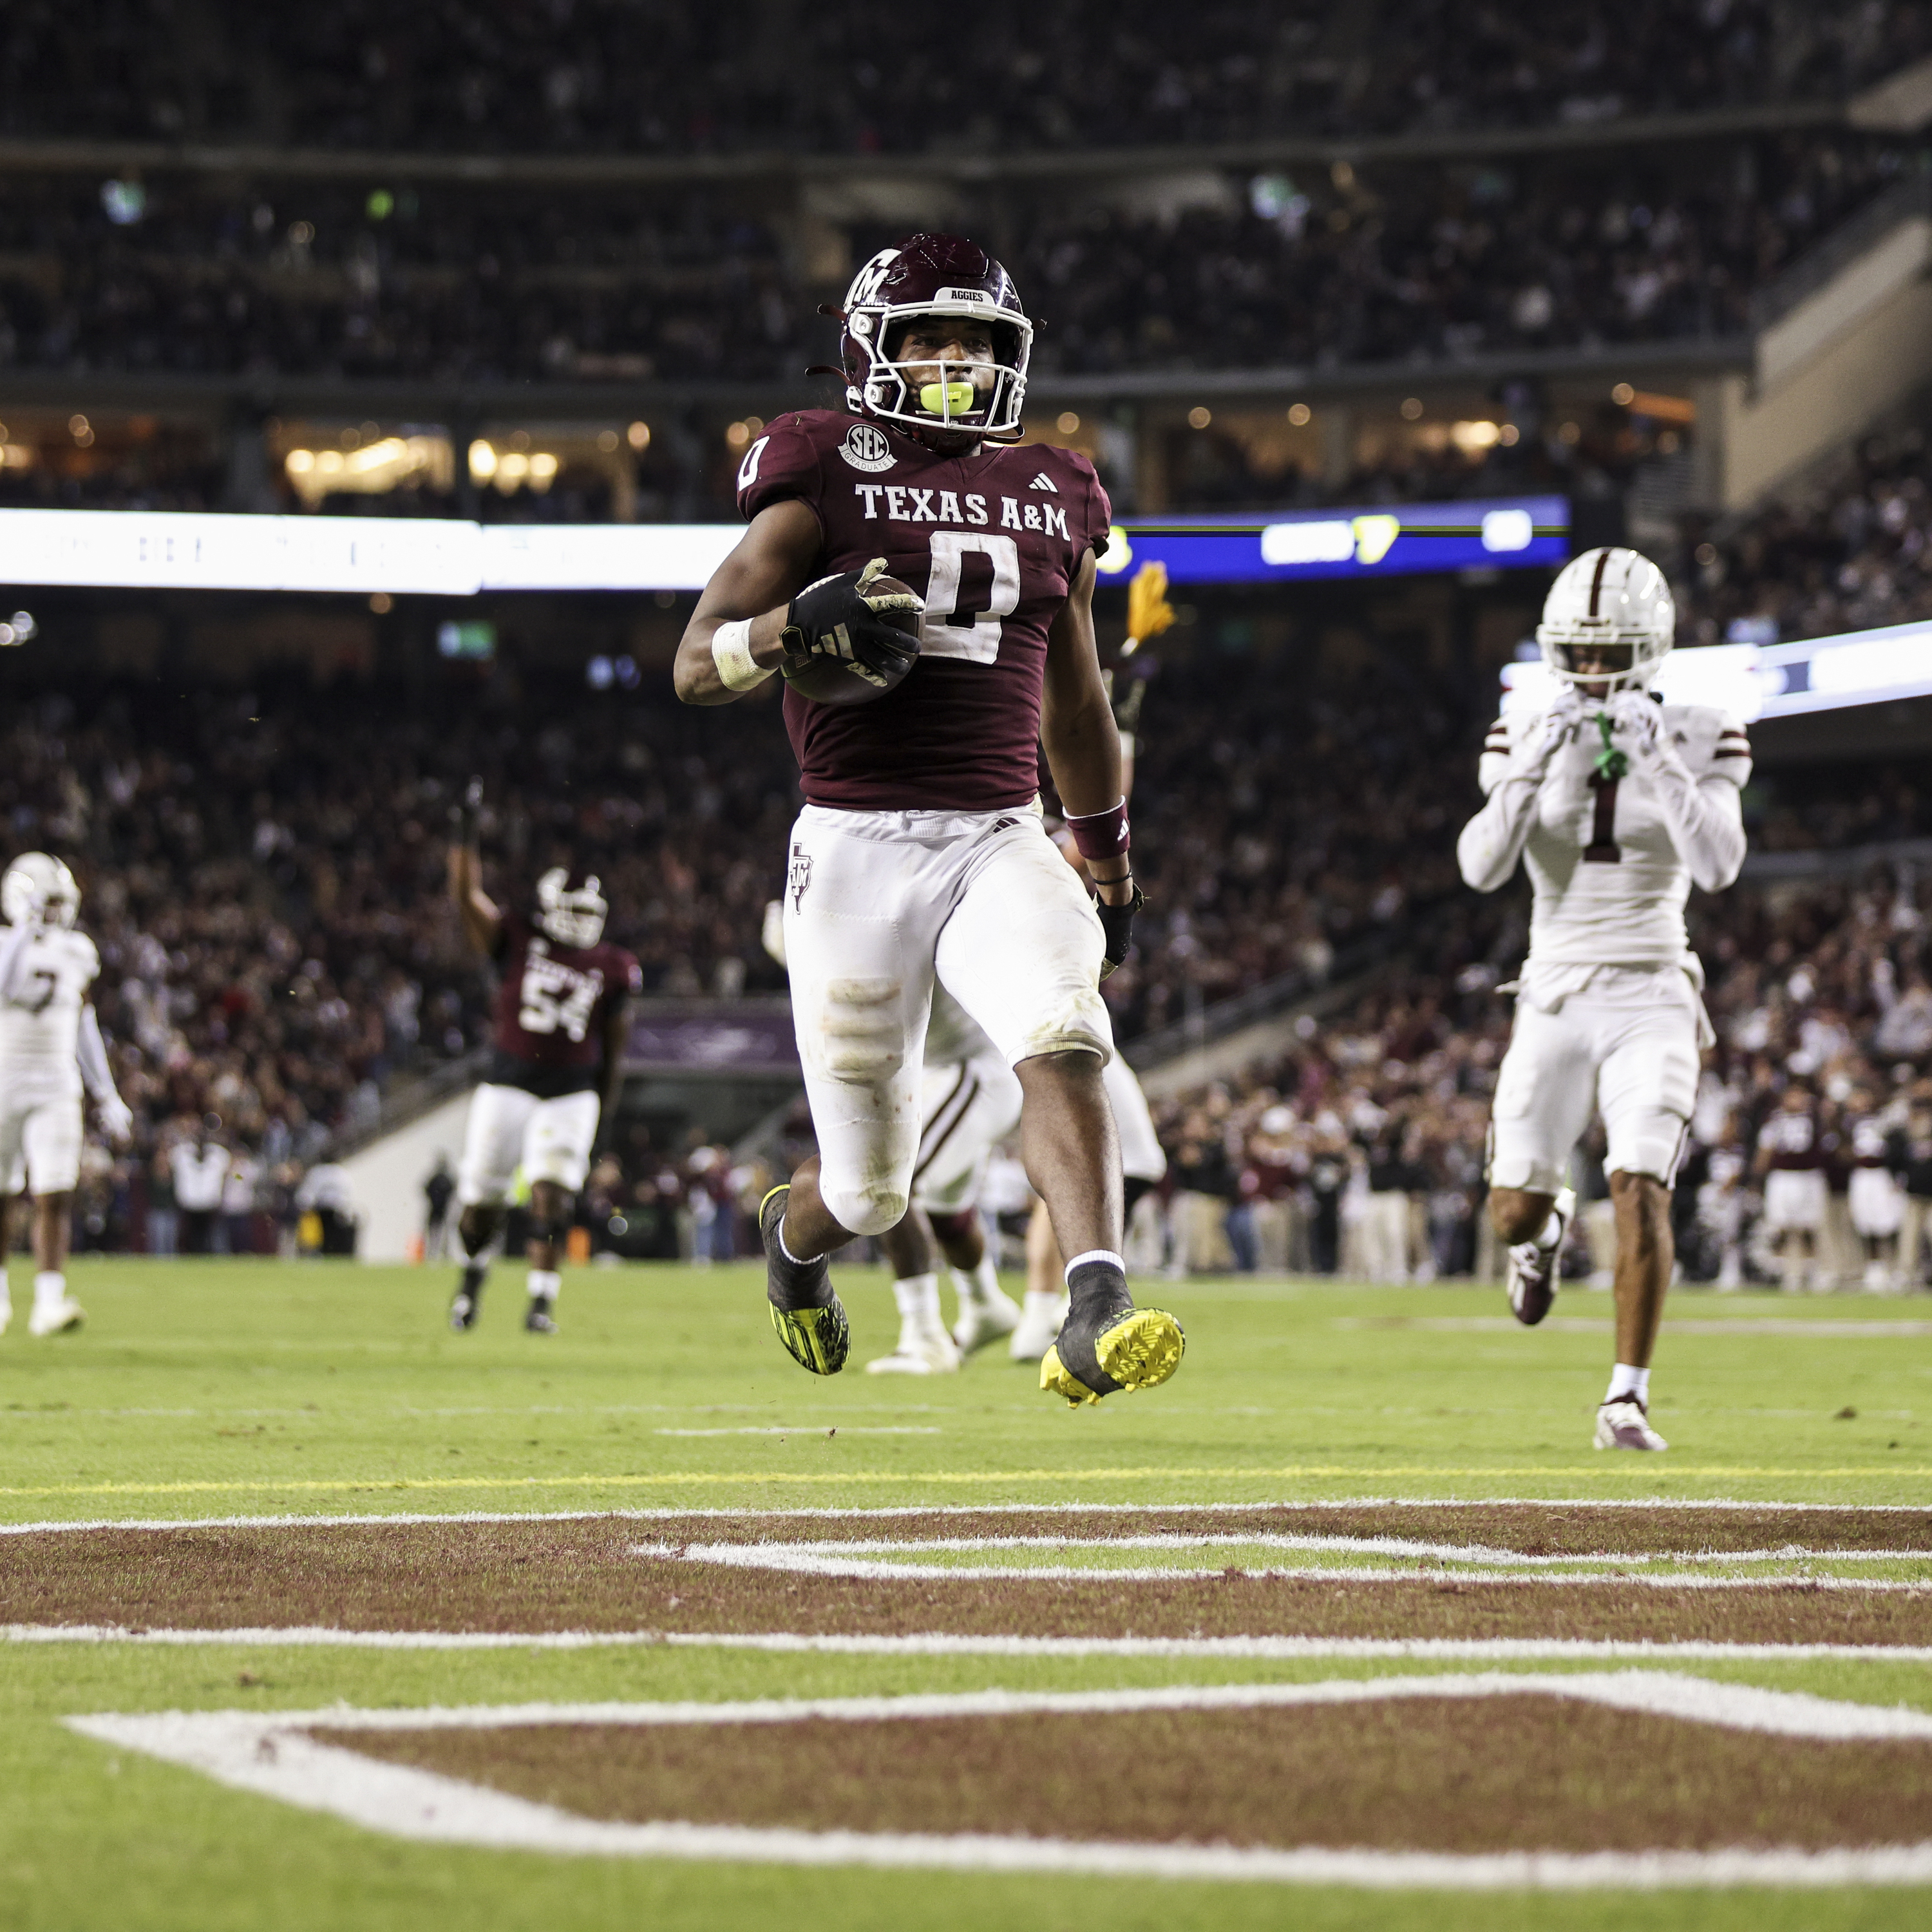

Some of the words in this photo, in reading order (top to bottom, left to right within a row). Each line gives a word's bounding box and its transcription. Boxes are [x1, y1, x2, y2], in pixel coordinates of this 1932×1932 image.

[951, 290, 983, 302] AGGIES
[738, 435, 770, 492] 0
[844, 453, 889, 471] GRADUATE
[851, 427, 885, 460] SEC
[855, 484, 989, 526] TEXAS
[1001, 496, 1071, 542] A&M
[918, 531, 1020, 665] 0
[1584, 768, 1622, 864] 1
[519, 969, 598, 1043] 54
